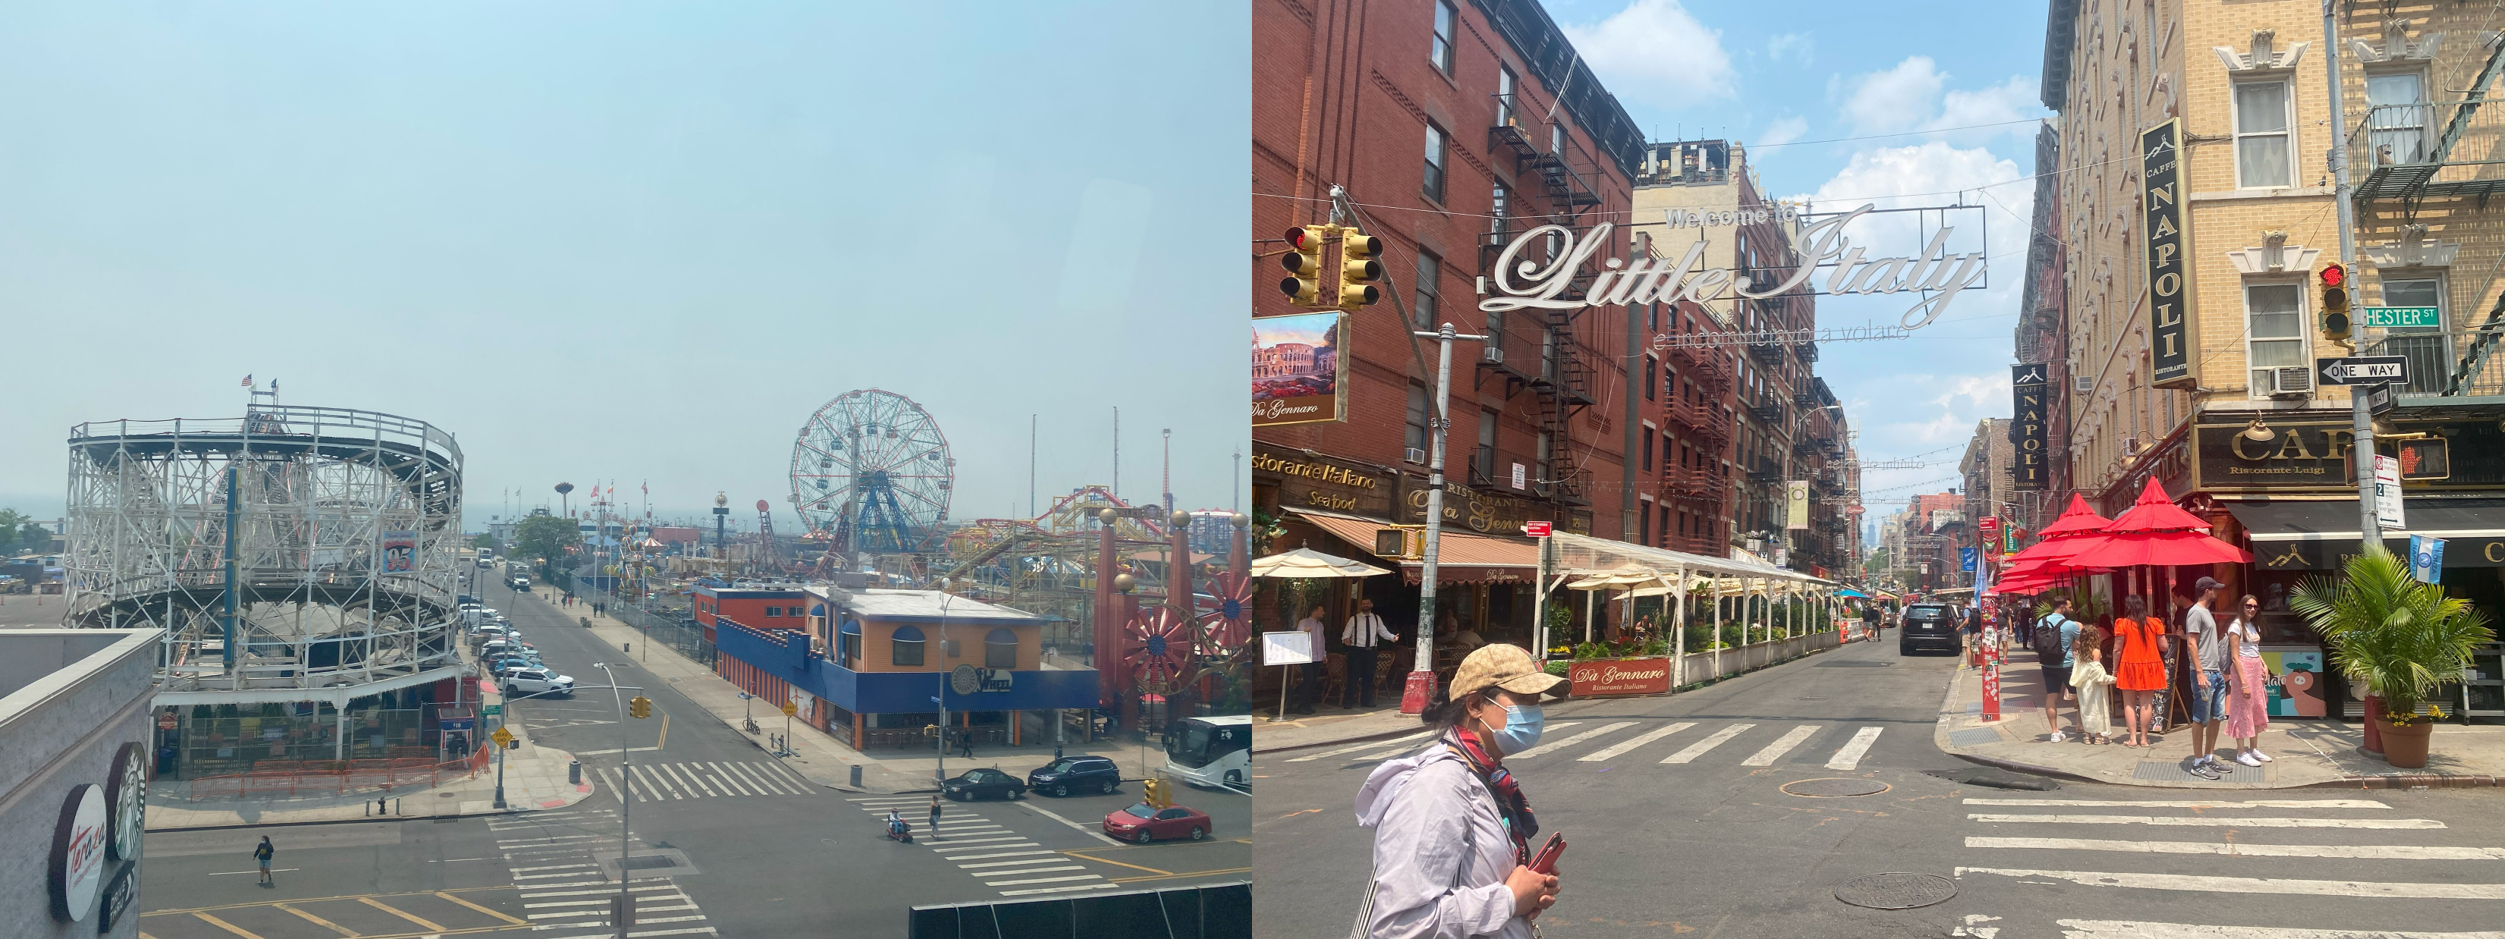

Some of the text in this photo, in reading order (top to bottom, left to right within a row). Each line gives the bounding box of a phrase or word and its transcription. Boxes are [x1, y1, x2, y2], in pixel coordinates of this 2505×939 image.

[2146, 160, 2177, 178] CAFFE
[1664, 204, 1798, 229] Welcome to
[1478, 203, 1988, 331] Little Italy
[2150, 181, 2181, 358] NAPOLI
[2365, 309, 2435, 325] HESTER ST
[1820, 326, 1832, 344] a
[2155, 363, 2187, 375] RISTORANTE
[2331, 365, 2395, 377] ONE WAY
[2017, 386, 2043, 394] CAFFE
[1267, 399, 1319, 419] Gennaro
[2022, 394, 2041, 480] NAPOLI
[1252, 453, 1376, 490] storante Italiano
[2229, 466, 2326, 476] Ristorante Luigi
[1309, 491, 1356, 511] Seafood
[1447, 483, 1527, 508] RISTORANTE
[1469, 500, 1527, 532] Genn
[387, 548, 411, 571] 95
[1574, 666, 1665, 684] Da Gennaro
